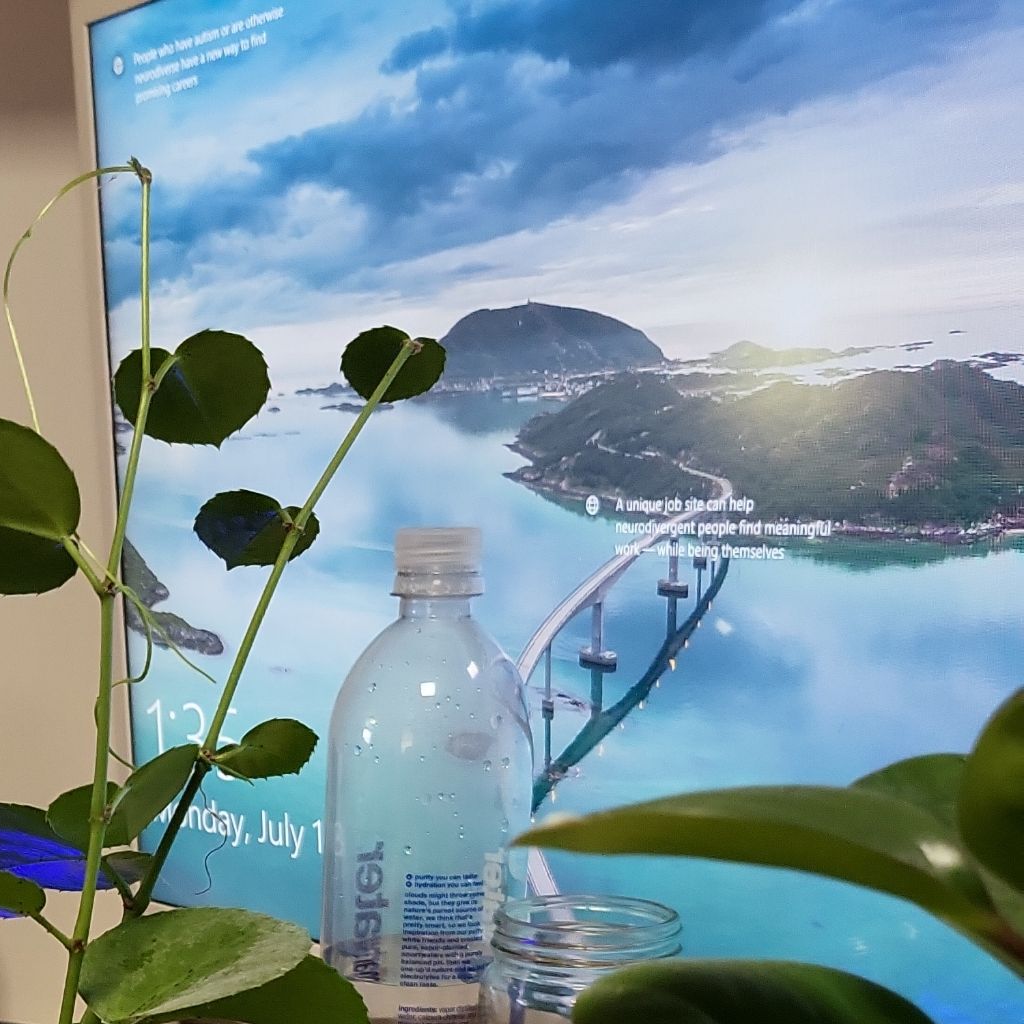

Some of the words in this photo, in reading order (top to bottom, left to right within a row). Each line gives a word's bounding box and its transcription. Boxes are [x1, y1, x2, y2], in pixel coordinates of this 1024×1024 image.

[133, 49, 157, 65] People
[157, 43, 174, 57] who
[175, 38, 193, 52] have
[194, 28, 220, 46] autism
[220, 25, 230, 37] or
[231, 20, 244, 34] are
[245, 6, 284, 29] otherwise
[180, 55, 199, 70] have
[206, 48, 223, 63] new
[223, 42, 239, 57] way
[240, 38, 250, 52] to
[250, 31, 266, 48] find
[616, 498, 624, 511] A
[626, 497, 663, 514] unique
[663, 497, 682, 516] job
[685, 496, 704, 512] site
[706, 499, 726, 511] can
[729, 496, 754, 514] help
[615, 519, 696, 537] neurodivergent
[697, 520, 736, 538] people
[738, 519, 762, 535] find
[763, 520, 831, 539] meaningful
[688, 542, 719, 560] being
[721, 543, 785, 559] themselves
[153, 799, 249, 847] Mnday,
[257, 810, 304, 859] July
